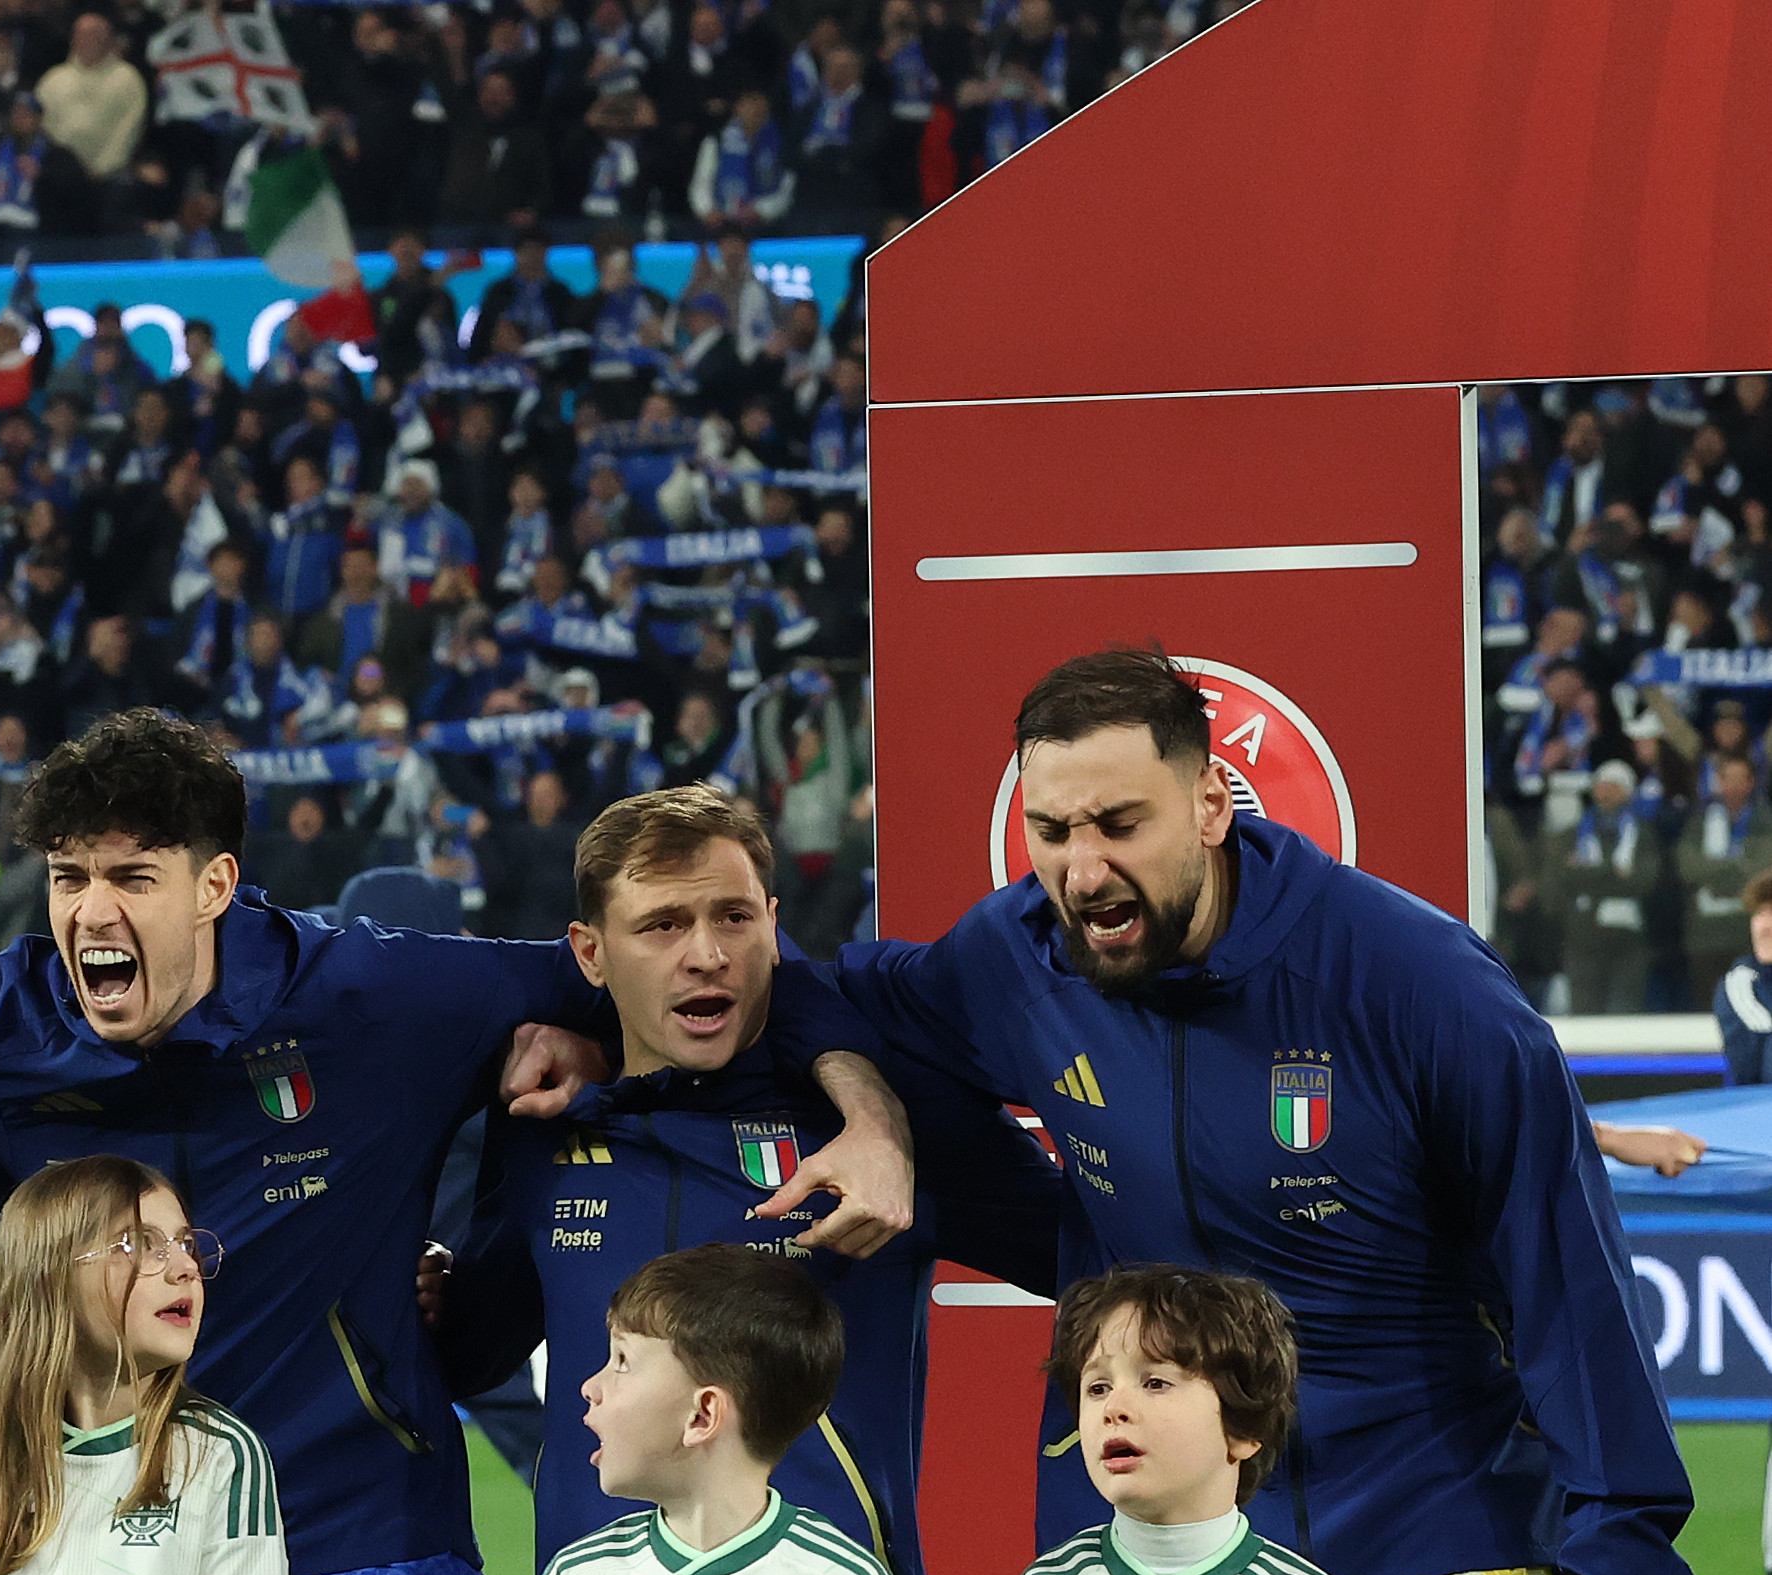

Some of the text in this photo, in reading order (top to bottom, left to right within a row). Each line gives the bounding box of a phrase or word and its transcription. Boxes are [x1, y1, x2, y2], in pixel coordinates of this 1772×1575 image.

[1276, 1071, 1326, 1088] ITALIA
[738, 1121, 791, 1137] ITALIA
[273, 1146, 330, 1166] Telepass
[1078, 1140, 1109, 1169] TIM
[263, 1180, 299, 1204] eni
[573, 1199, 609, 1219] TIM
[551, 1227, 602, 1248] Poste
